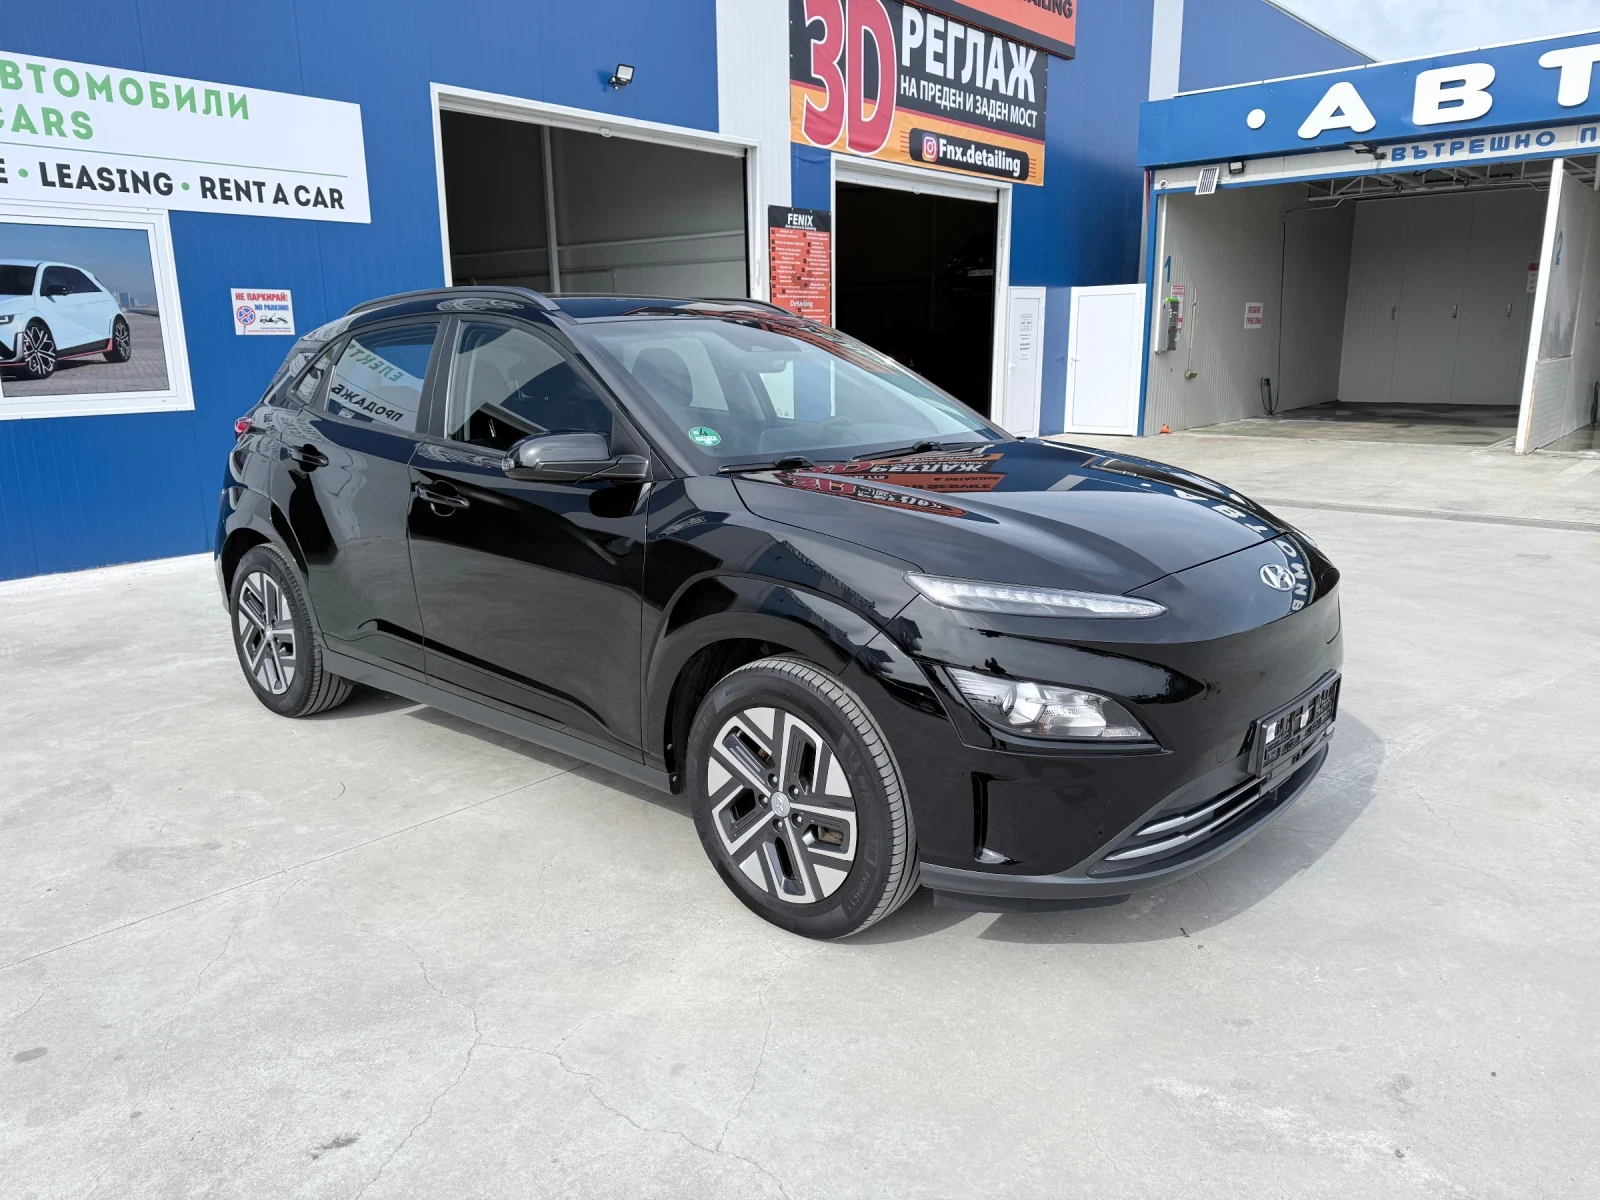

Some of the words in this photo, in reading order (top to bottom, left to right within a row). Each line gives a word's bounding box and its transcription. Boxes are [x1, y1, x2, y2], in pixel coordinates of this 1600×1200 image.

[901, 5, 1038, 103] РЕГЛАЖ
[802, 0, 897, 156] 3D
[900, 74, 917, 99] НА
[919, 79, 964, 111] ПРЕДЕН
[965, 92, 974, 113] И
[975, 95, 1009, 123] ЗАДЕН
[1010, 104, 1038, 128] МОСТ
[939, 138, 1021, 177] Fnx.detailing
[1391, 131, 1556, 162] ВЪТРЕШНО
[39, 162, 174, 196] LEASING
[200, 176, 267, 204] RENT
[272, 182, 290, 205] A
[294, 184, 345, 210] CAR
[787, 213, 814, 227] FENIX
[1555, 229, 1563, 265] 2
[1164, 255, 1172, 283] 1
[235, 292, 245, 301] НЕ
[247, 292, 288, 302] ПАРКИРАЙ!
[789, 299, 814, 308] Detailing
[850, 870, 871, 908] PRIMACY
